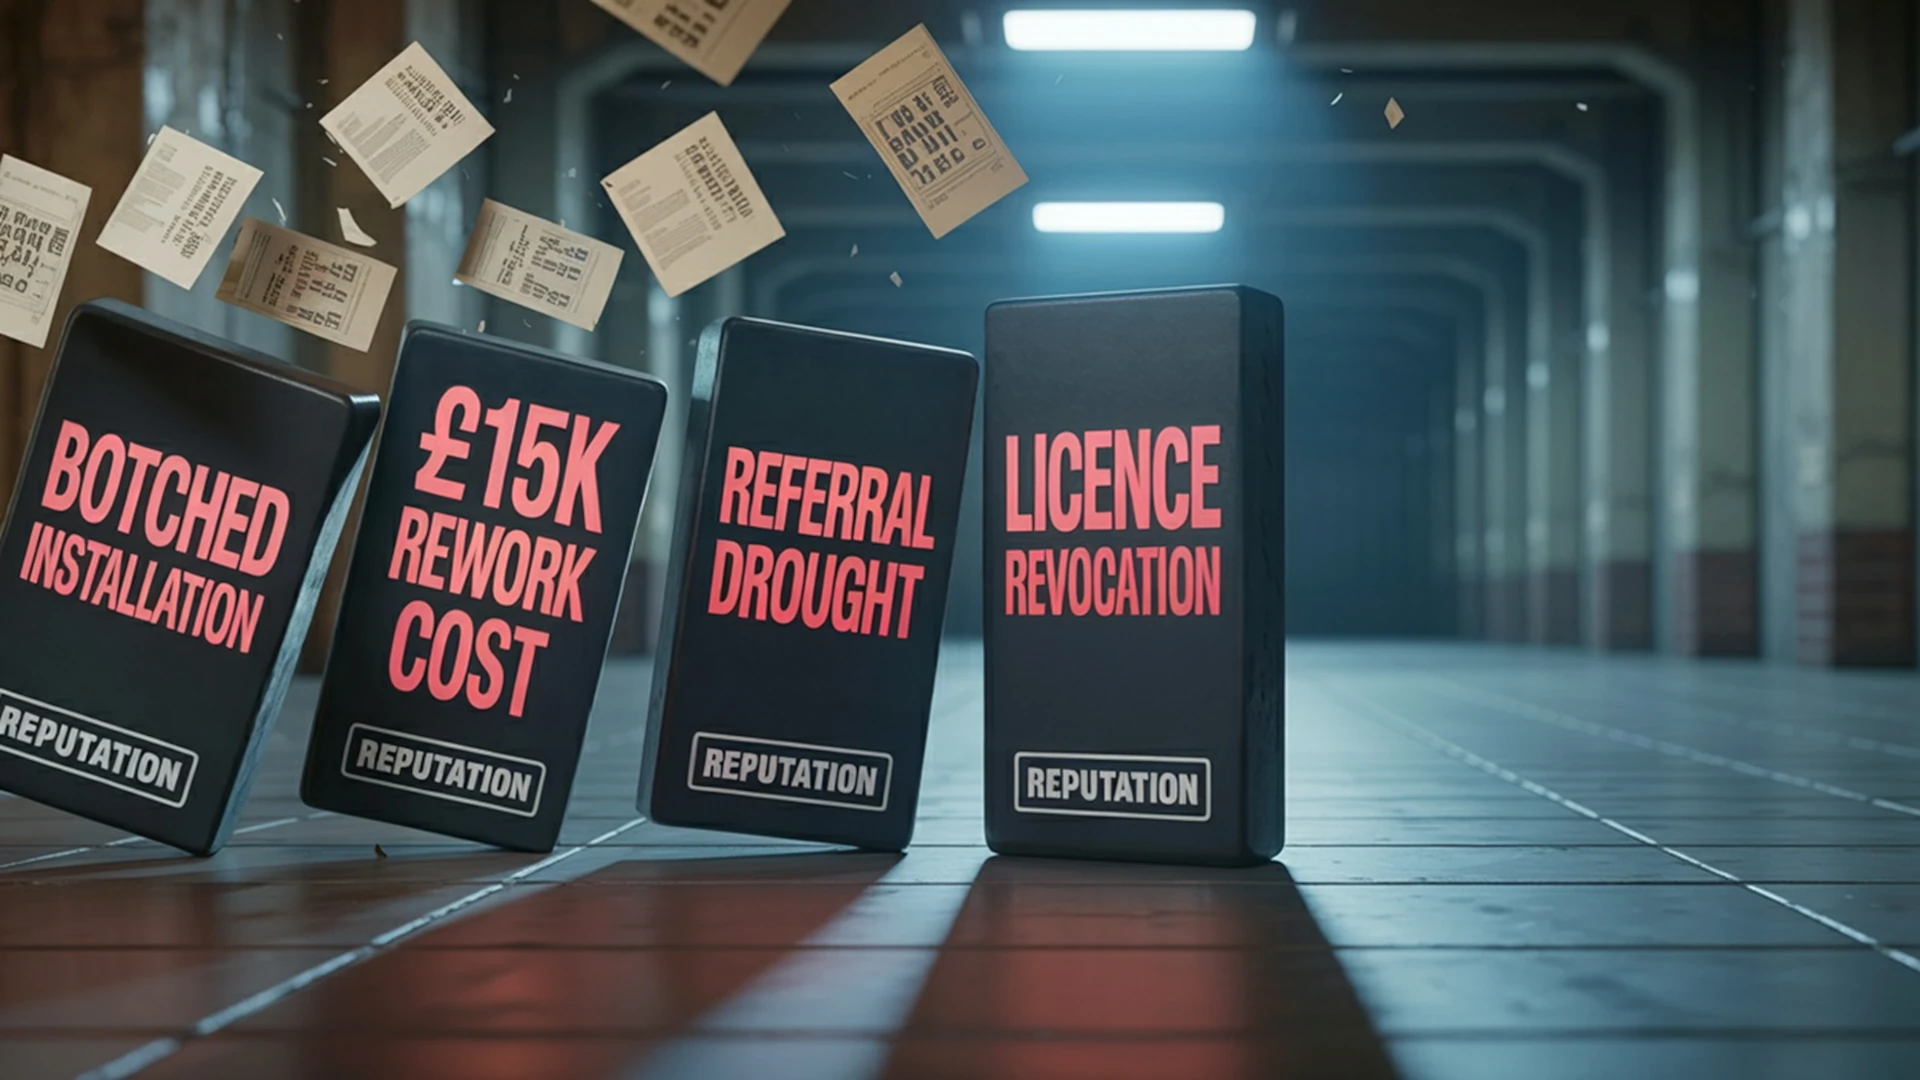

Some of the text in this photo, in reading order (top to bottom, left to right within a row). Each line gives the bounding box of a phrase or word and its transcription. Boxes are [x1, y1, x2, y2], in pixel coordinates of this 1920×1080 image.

[41, 420, 290, 577] BOTCHED
[416, 386, 620, 533] £15K
[719, 446, 935, 550] REFERRAL
[1005, 425, 1222, 532] LICENCE
[20, 521, 264, 653] INSTALLATION
[388, 505, 596, 622] REWORK
[708, 539, 925, 639] DROUGHT
[1005, 545, 1221, 616] REVOCATION
[389, 600, 550, 718] COST
[0, 704, 183, 792] REPUTATION
[356, 738, 532, 802] REPUTATION
[702, 746, 878, 797] REPUTATION
[1027, 766, 1198, 806] REPUTATION
